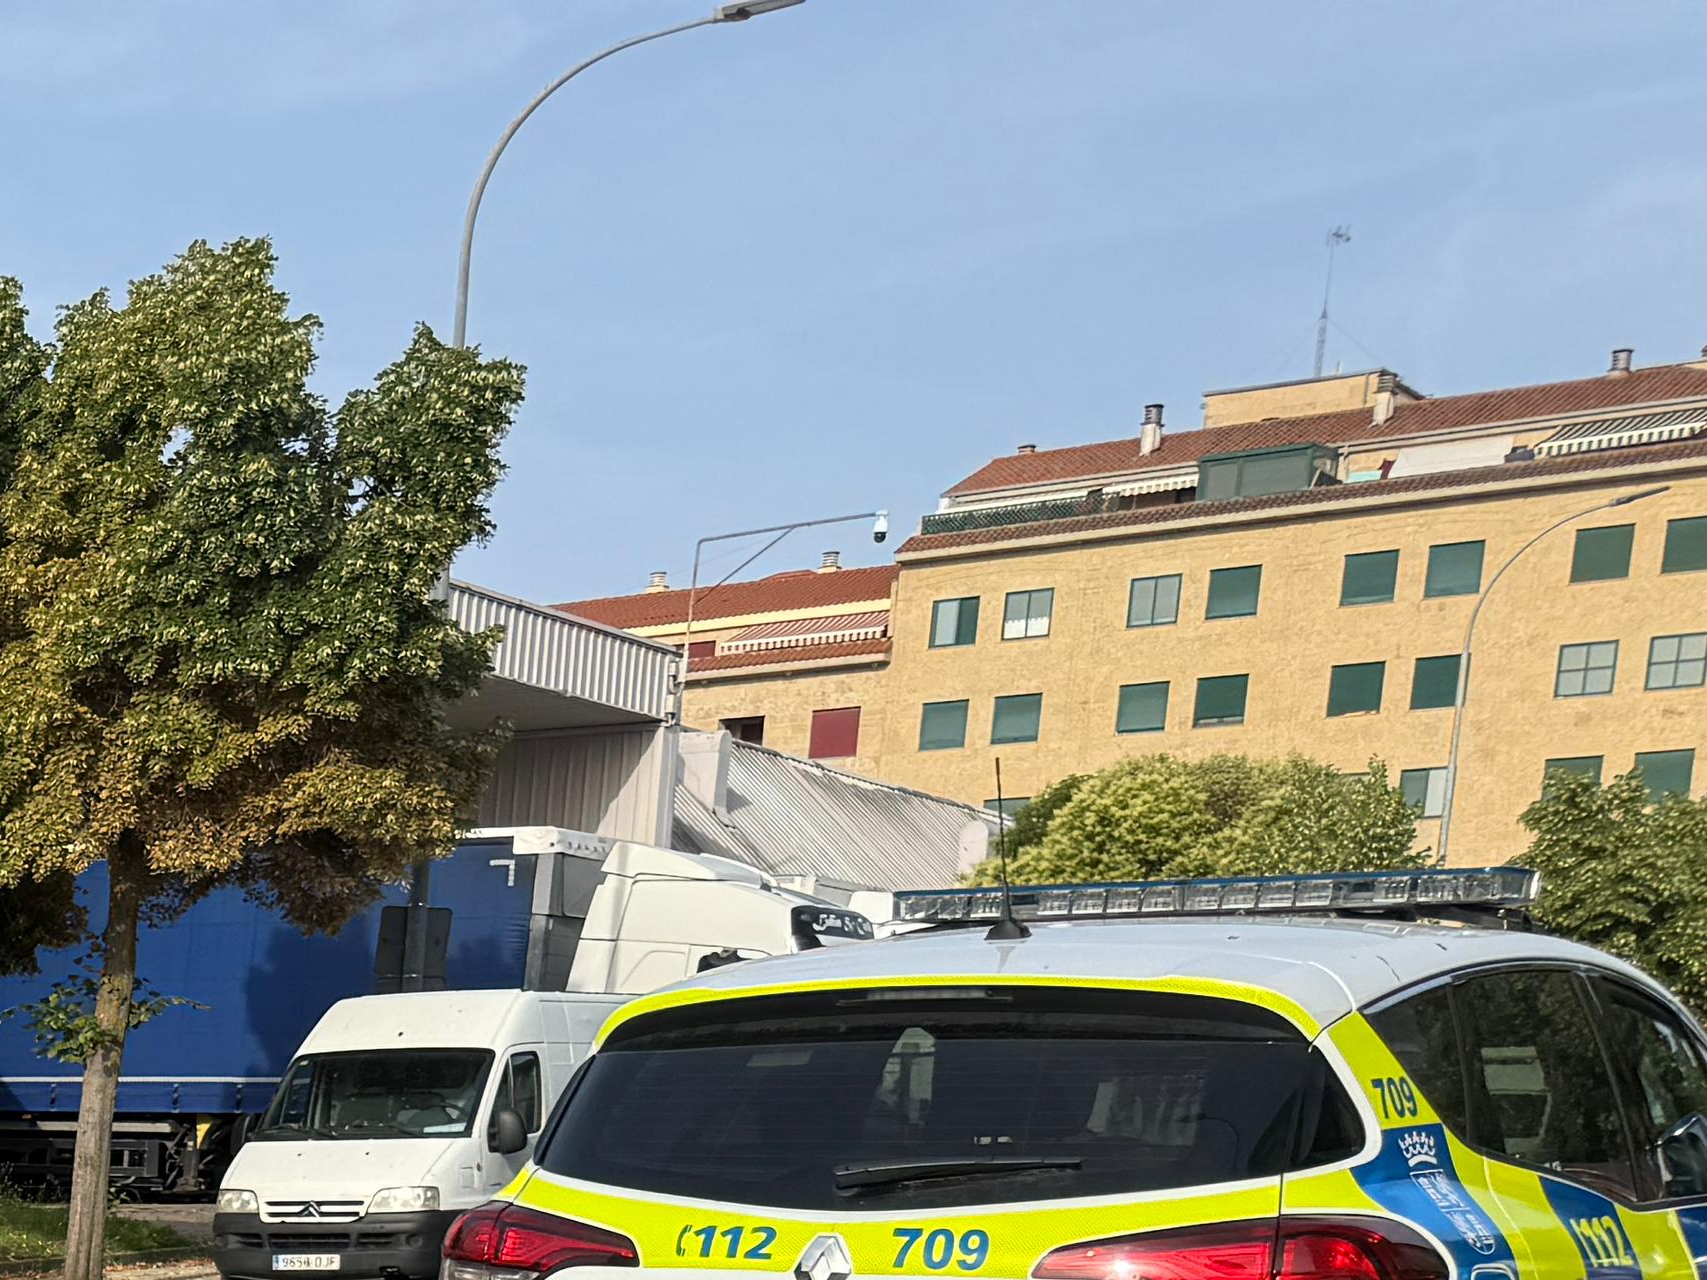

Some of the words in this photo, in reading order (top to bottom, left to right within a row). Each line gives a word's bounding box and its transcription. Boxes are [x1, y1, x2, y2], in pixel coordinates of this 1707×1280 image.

[1370, 1076, 1419, 1119] 709
[694, 1225, 778, 1260] 112
[892, 1227, 991, 1272] 709
